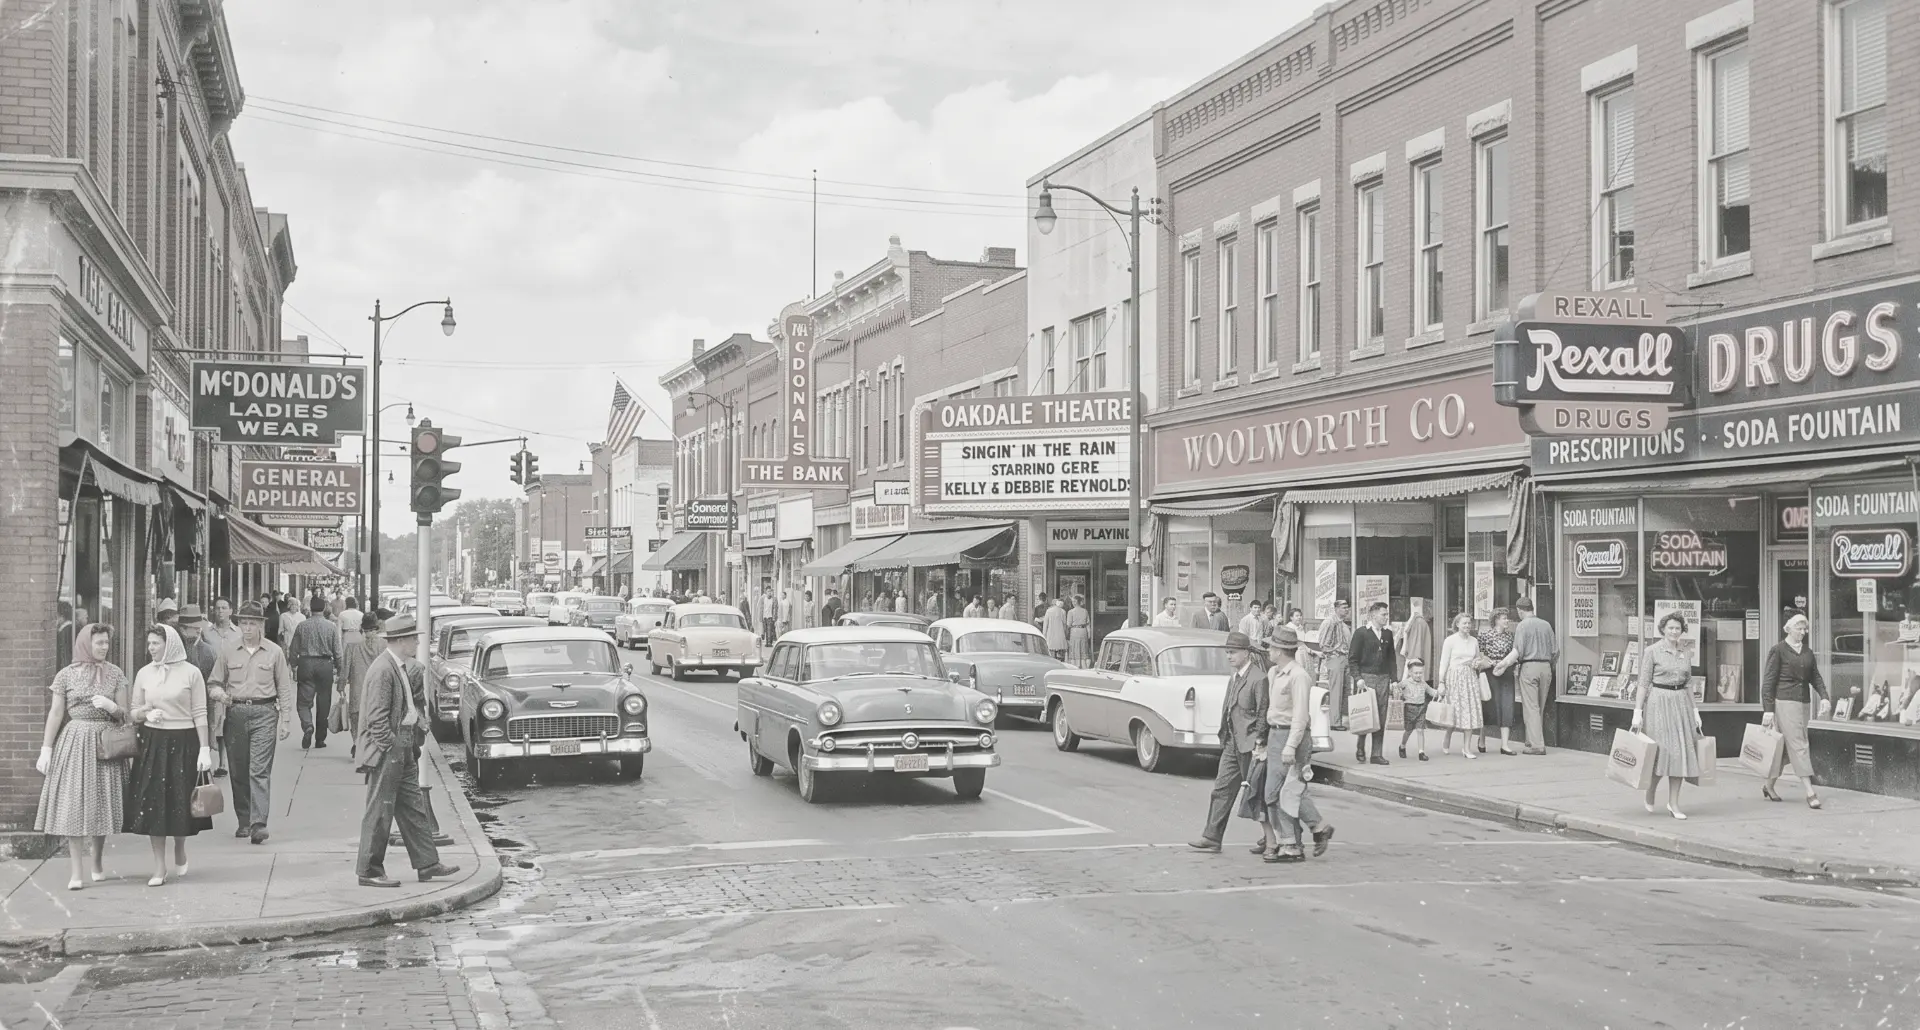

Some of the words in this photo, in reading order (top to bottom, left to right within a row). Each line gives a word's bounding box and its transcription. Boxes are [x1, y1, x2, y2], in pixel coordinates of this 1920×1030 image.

[79, 255, 104, 315] THE
[1555, 296, 1653, 319] REXALL
[1708, 302, 1901, 393] DRUGS
[1526, 329, 1674, 395] Rexall
[229, 402, 328, 419] LADIES
[941, 402, 1033, 428] OAKDALE
[1041, 398, 1131, 424] THEATRE
[1555, 408, 1652, 429] DRUGS
[237, 420, 319, 437] WEAR
[1183, 405, 1388, 471] WOOLWORTH
[1410, 393, 1475, 441] CO.
[1723, 418, 1779, 449] SODA
[1788, 402, 1901, 442] FOUNTAIN
[1022, 443, 1036, 457] IN
[1043, 442, 1071, 457] THE
[1080, 440, 1116, 456] RAIN
[747, 464, 784, 481] THE
[792, 465, 844, 482] BANK
[1061, 461, 1100, 474] GERE
[252, 468, 351, 487] GENERAL
[945, 481, 987, 496] KELLY
[991, 481, 1000, 494] &
[1004, 480, 1054, 494] DEBBIE
[244, 489, 357, 507] APPLIANCES
[1815, 494, 1850, 517] SODA
[1563, 509, 1588, 527] SODA
[1590, 506, 1636, 526] FOUNTAIN
[1052, 528, 1078, 540] NOW
[1660, 534, 1702, 549] SODA
[1652, 550, 1725, 567] FOUNTAIN
